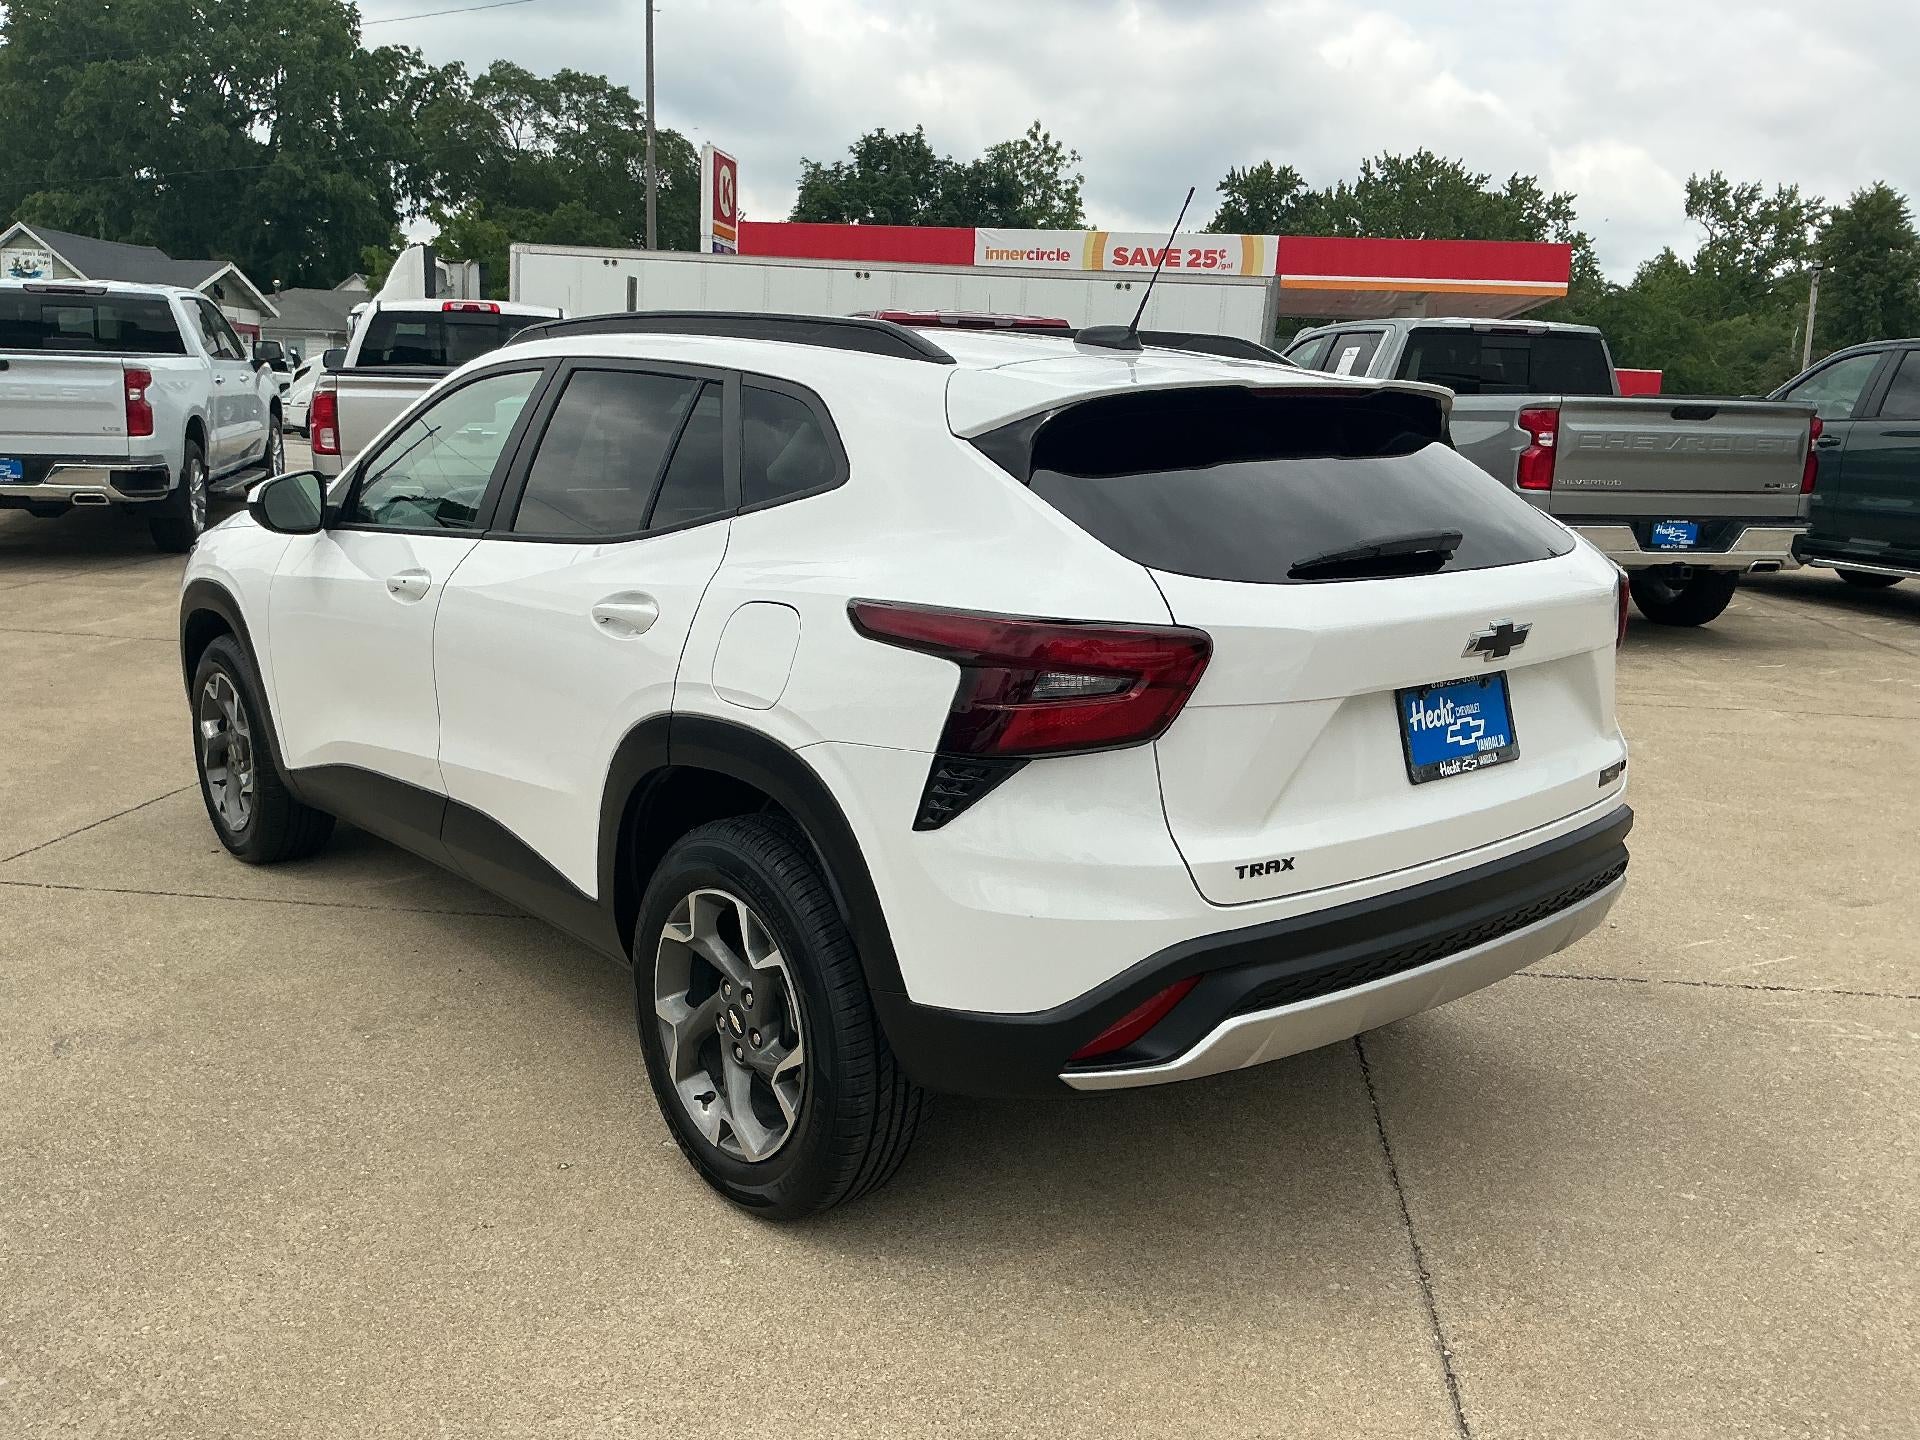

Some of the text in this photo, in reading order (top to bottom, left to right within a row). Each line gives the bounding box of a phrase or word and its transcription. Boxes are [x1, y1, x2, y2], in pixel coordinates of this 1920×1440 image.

[723, 176, 733, 211] K
[986, 246, 1071, 262] innercircle
[1112, 246, 1182, 268] SAVE
[1578, 432, 1796, 453] CHEVROLET
[1558, 479, 1622, 487] SILVERADO
[1410, 696, 1455, 732] Hecht
[1455, 703, 1480, 717] CHEVROLET
[1476, 733, 1506, 752] VANDALIA
[1439, 759, 1461, 777] Hecht
[1235, 856, 1295, 880] TRAX
